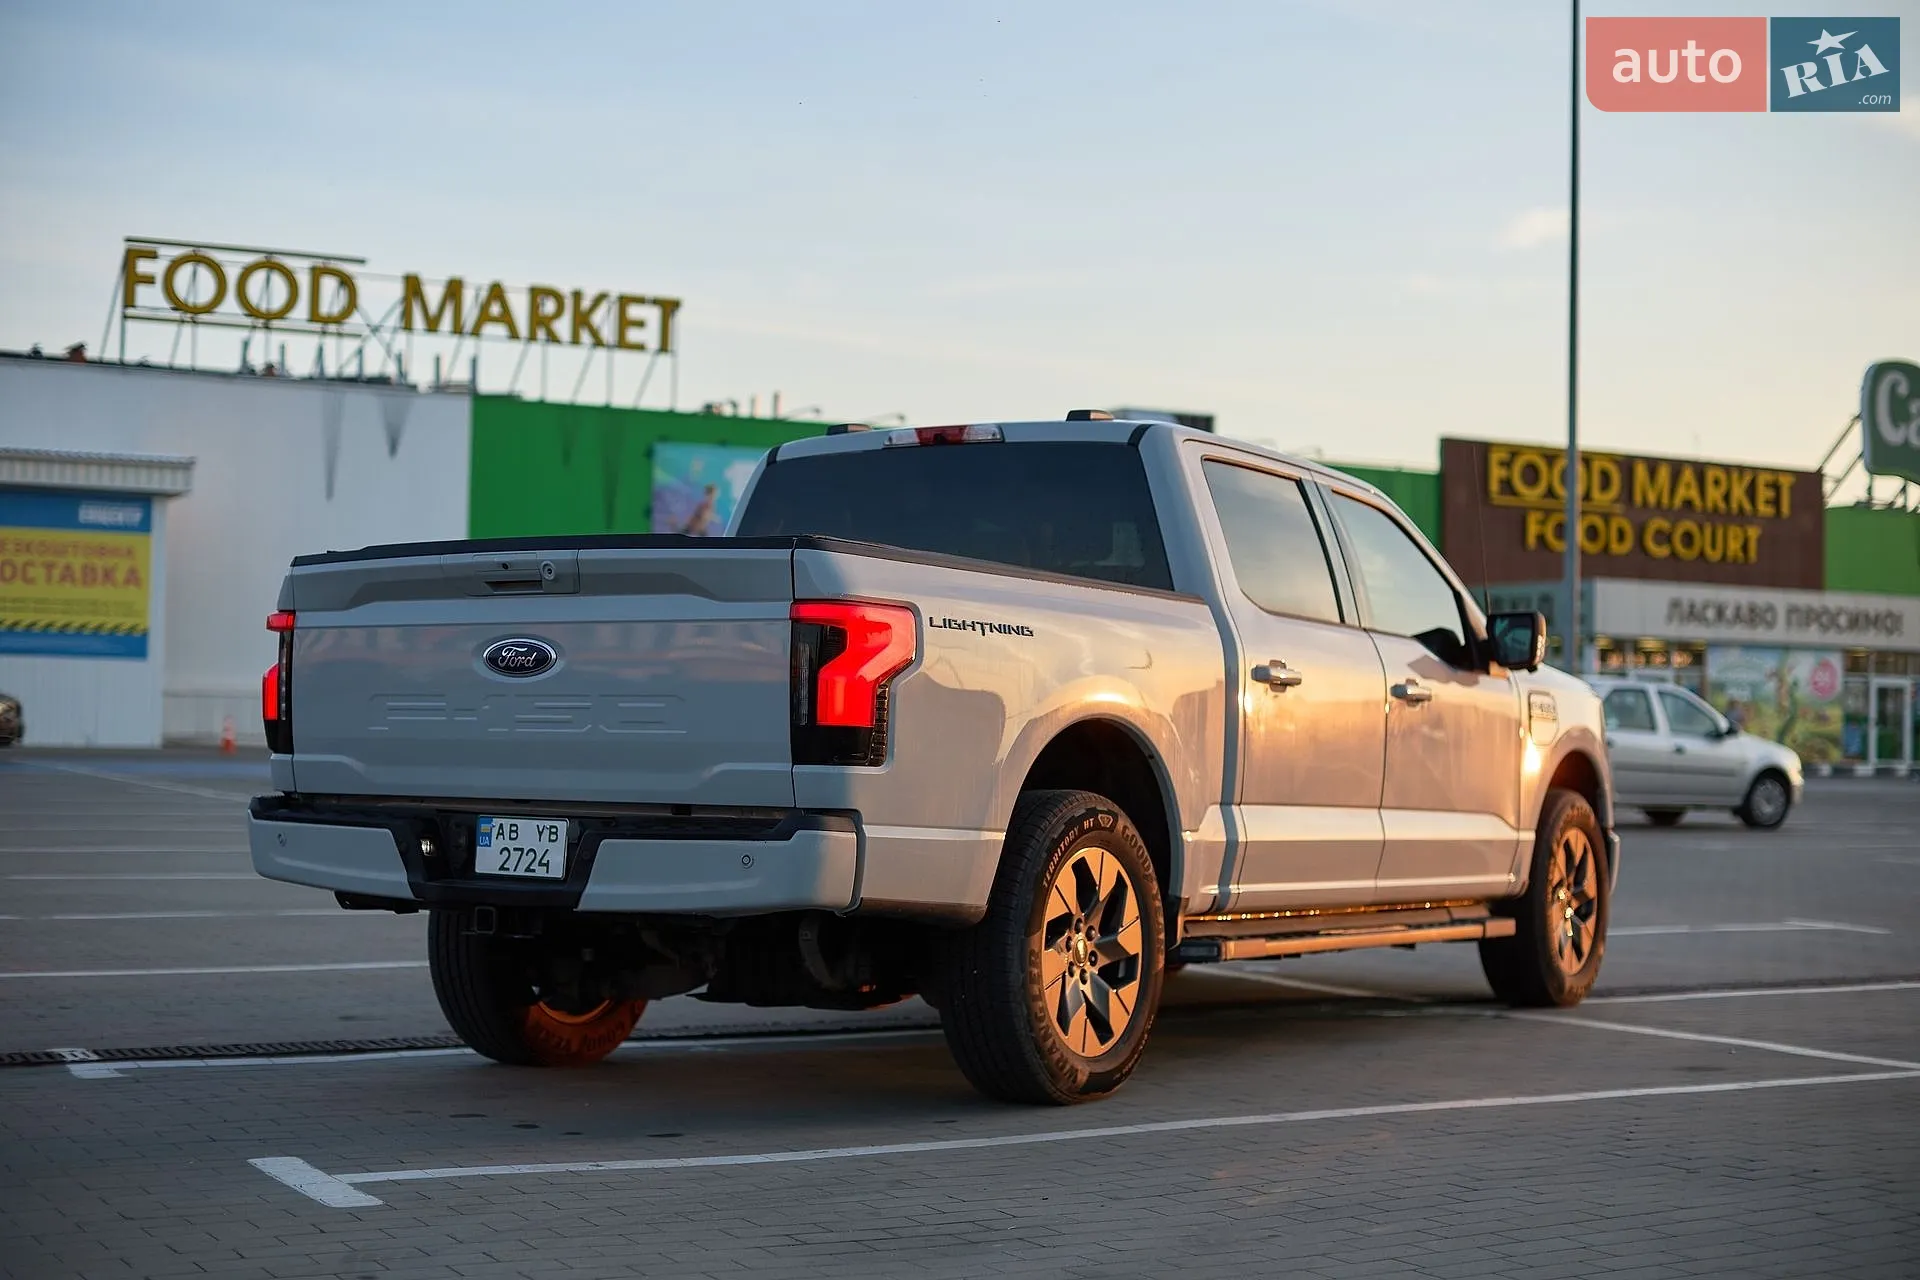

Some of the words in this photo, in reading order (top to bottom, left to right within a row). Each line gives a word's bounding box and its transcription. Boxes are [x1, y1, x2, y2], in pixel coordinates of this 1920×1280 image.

[125, 247, 357, 324] FOOD
[402, 273, 682, 353] MARKET
[1488, 447, 1623, 503] FOOD
[1631, 459, 1796, 518] MARKET
[1525, 510, 1635, 555] FOOD
[1643, 517, 1762, 563] COURT
[1666, 597, 1778, 631] ЛАСКАВО
[928, 616, 1034, 637] LIGHTNING
[498, 646, 537, 667] Ford
[496, 823, 520, 841] AB
[1083, 818, 1095, 830] HT
[480, 836, 491, 846] UA
[498, 846, 550, 874] 2724
